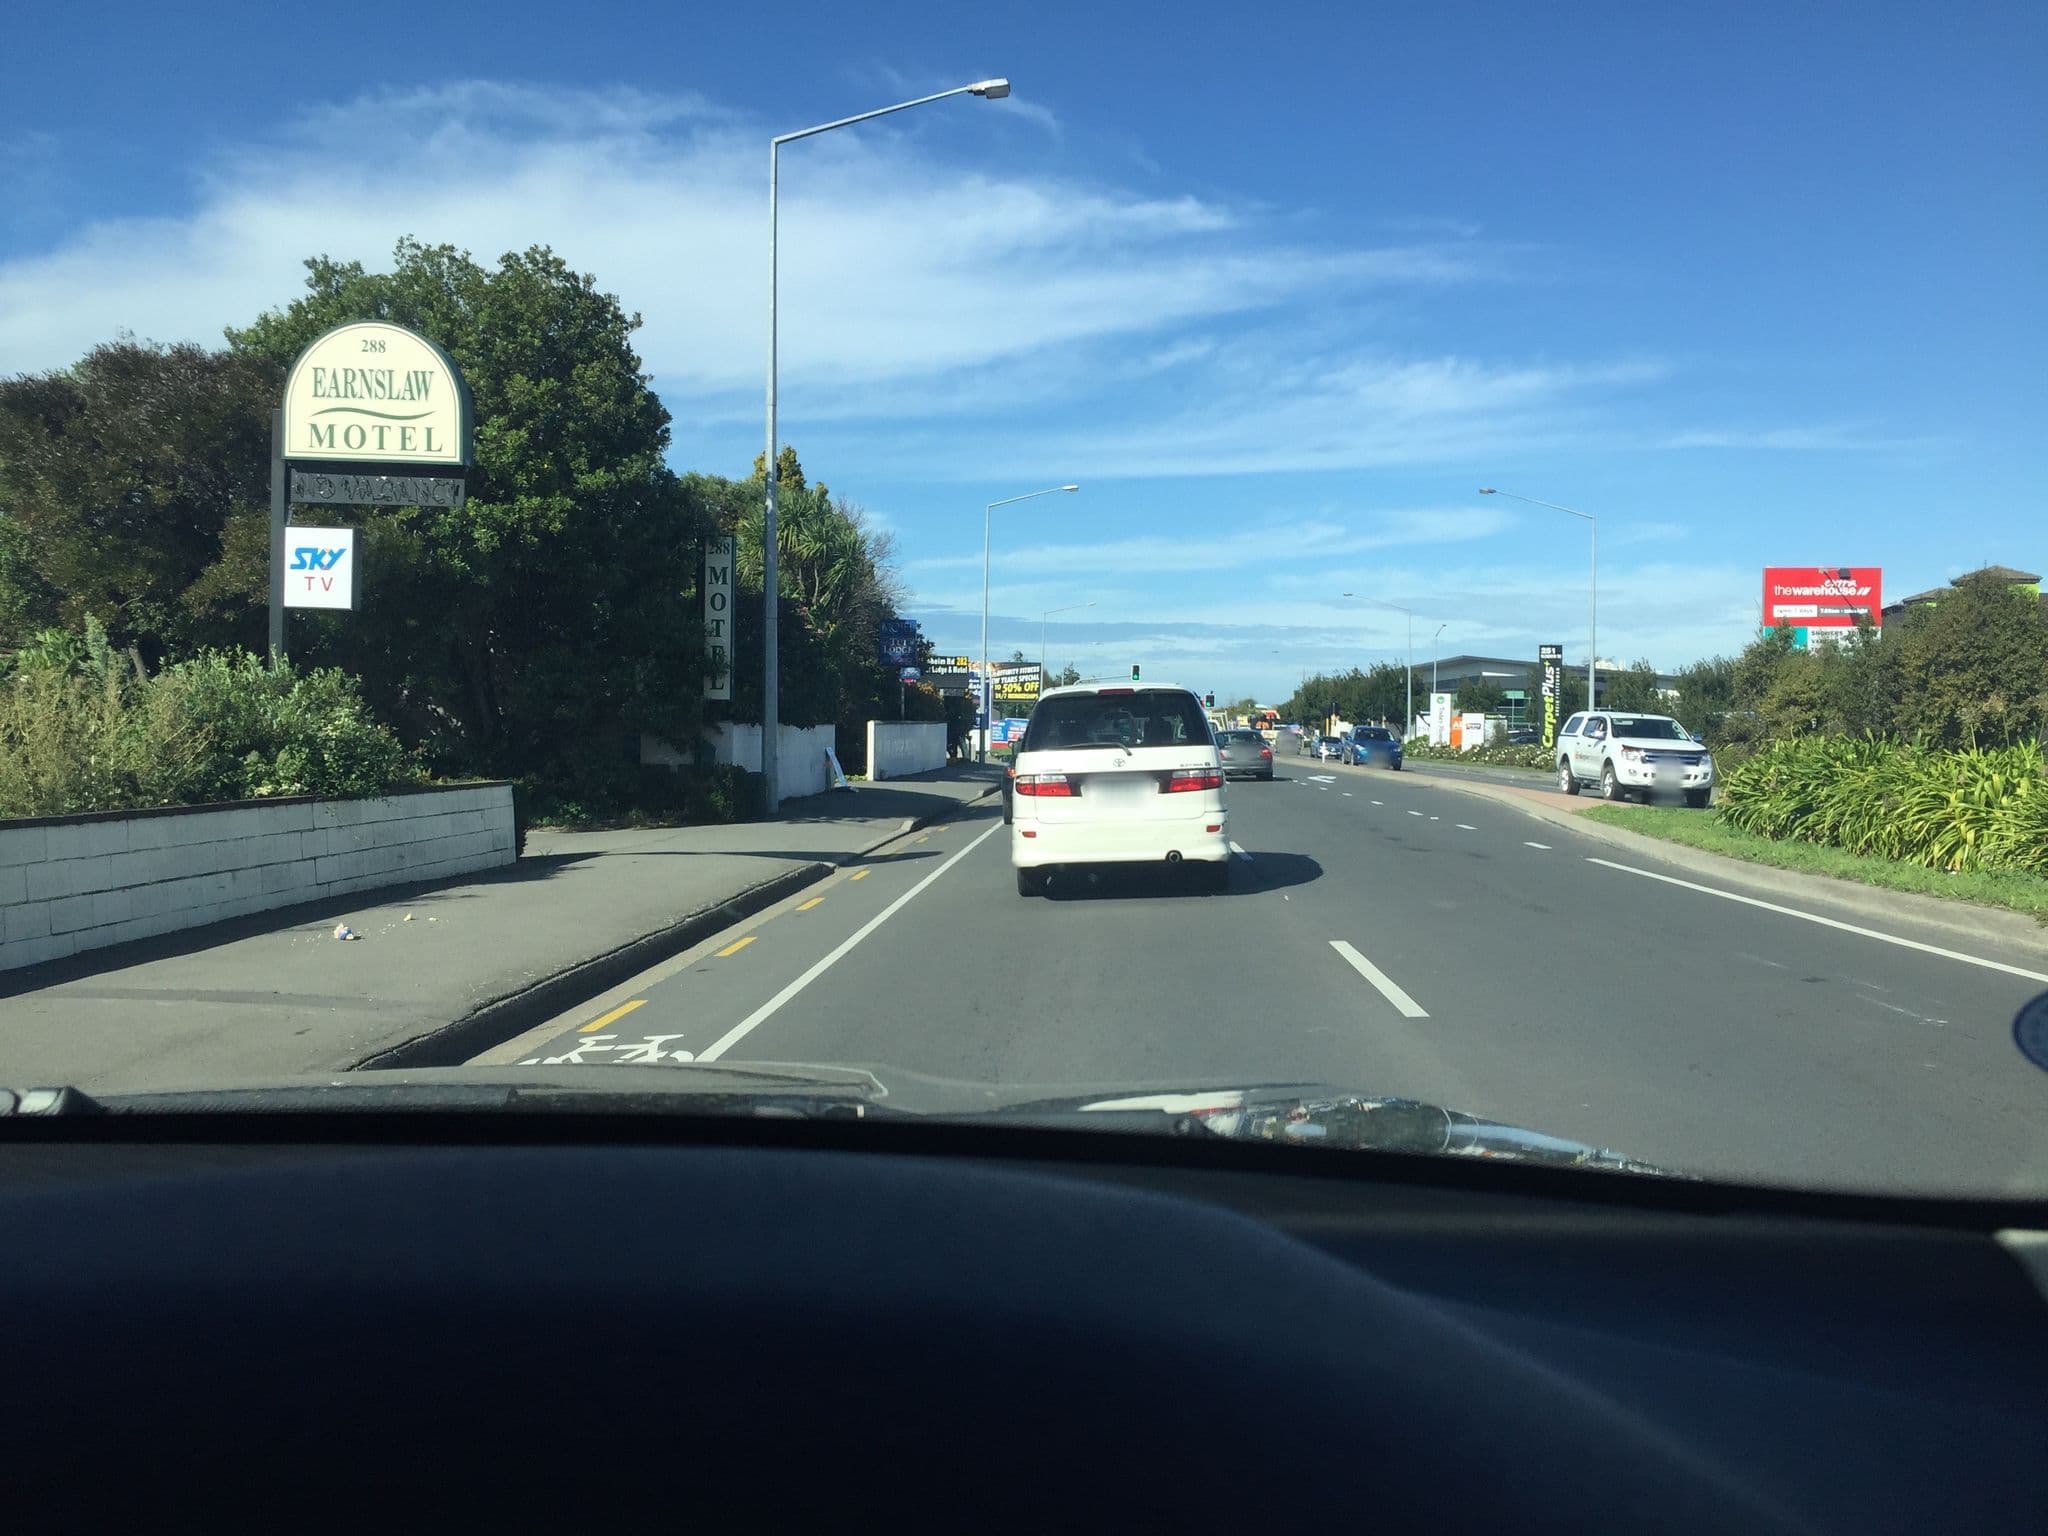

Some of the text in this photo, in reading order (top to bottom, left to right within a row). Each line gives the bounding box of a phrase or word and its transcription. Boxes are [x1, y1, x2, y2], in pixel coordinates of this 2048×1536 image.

[361, 339, 386, 353] 288
[311, 366, 434, 401] EARNSLAW
[308, 423, 443, 453] MOTEL
[290, 547, 347, 571] SKY
[1002, 683, 1022, 693] 50%
[1024, 681, 1040, 692] OFF
